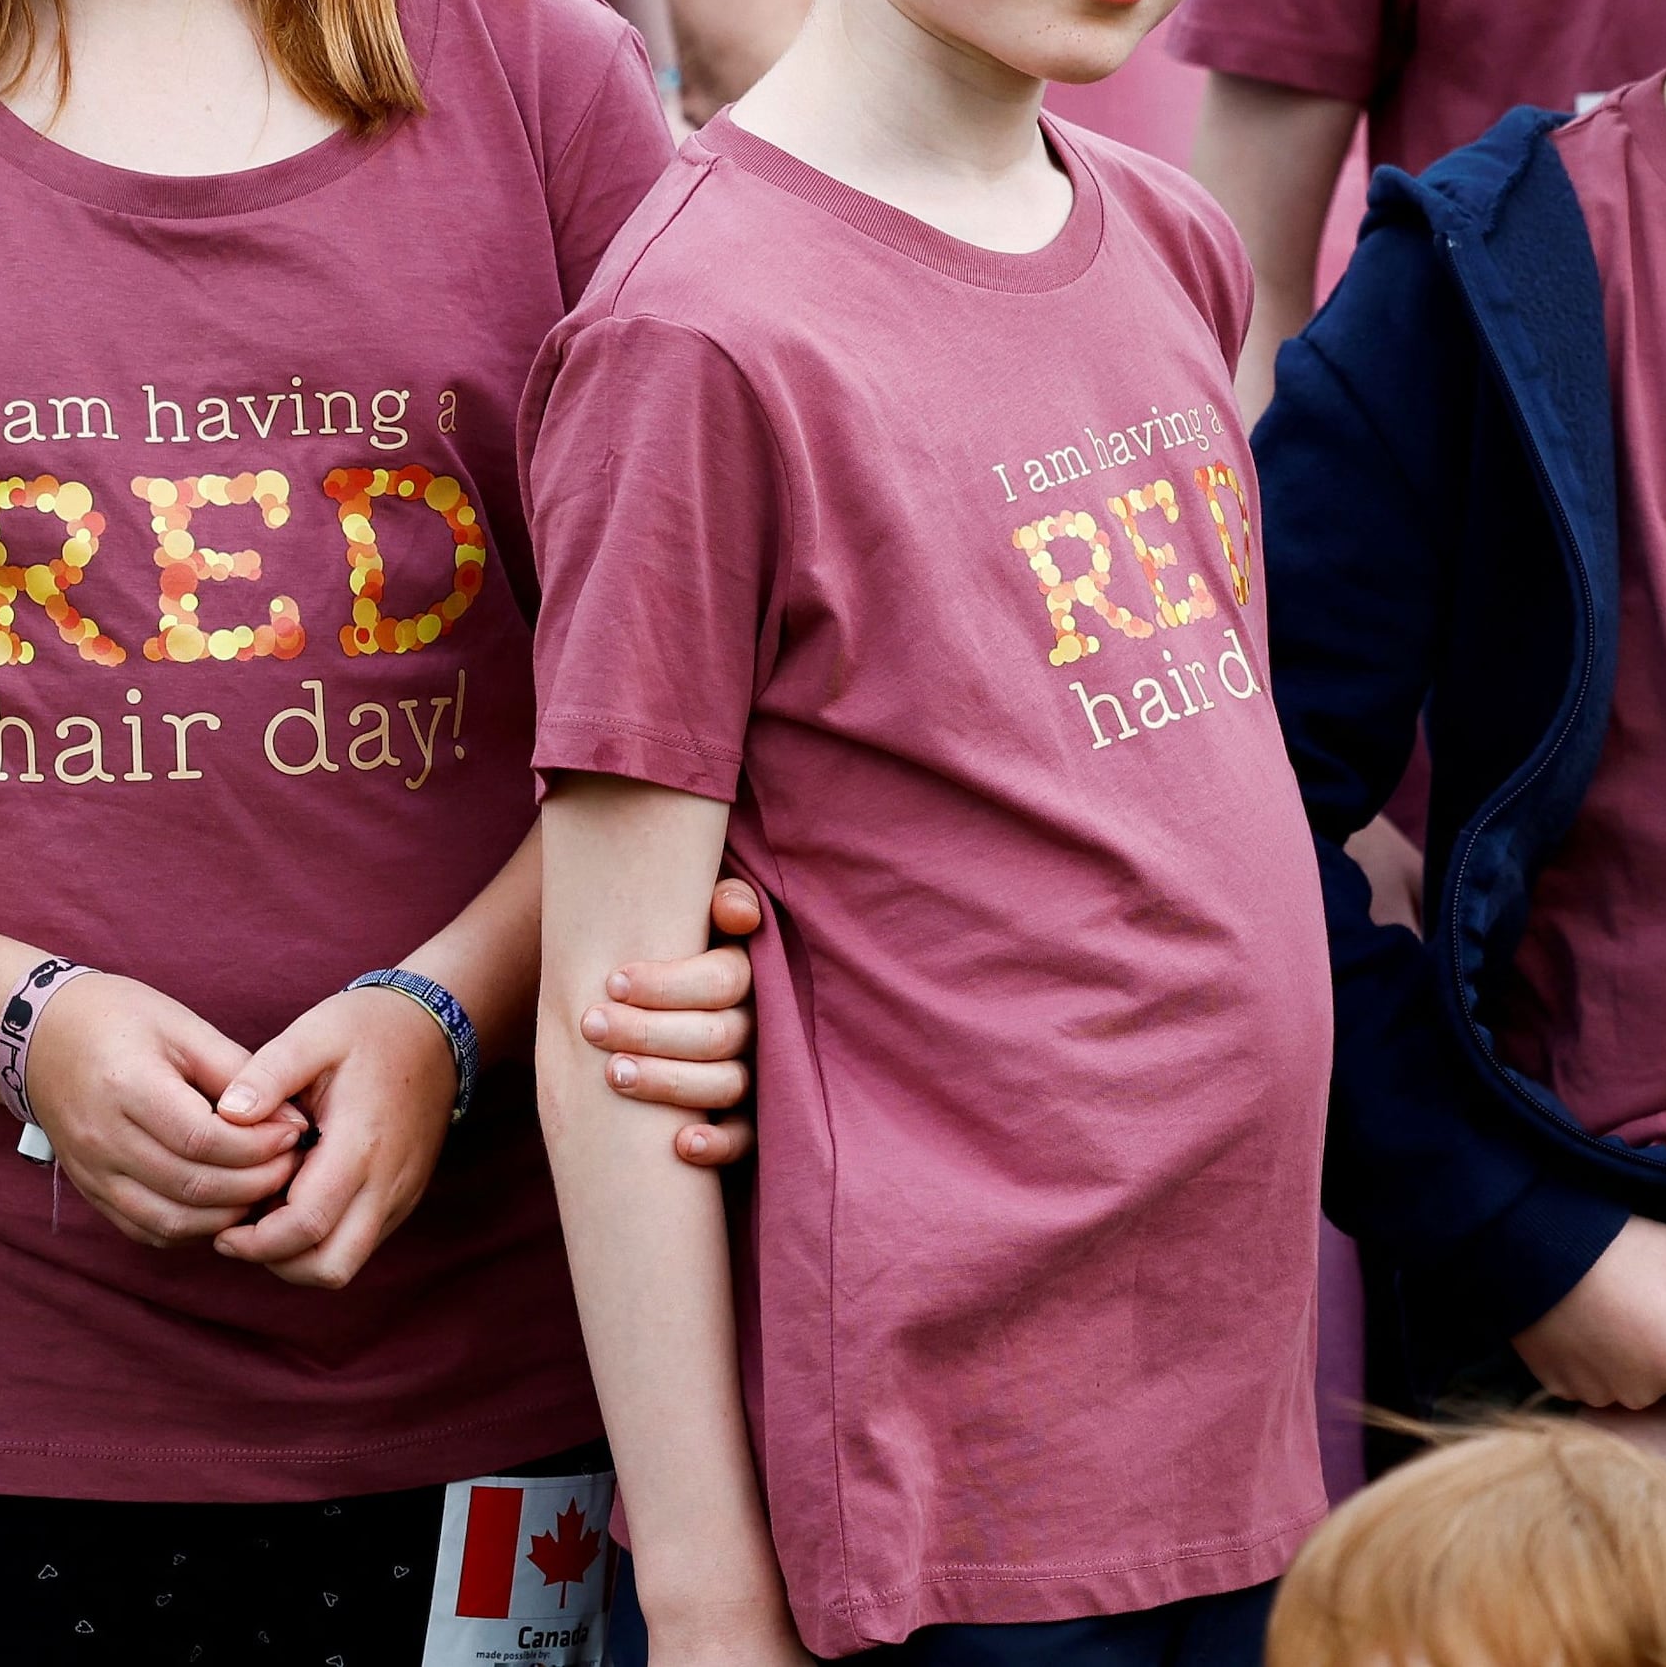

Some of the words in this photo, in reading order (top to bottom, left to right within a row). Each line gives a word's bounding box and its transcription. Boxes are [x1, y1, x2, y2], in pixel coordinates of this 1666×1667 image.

[2, 395, 120, 445] am
[141, 375, 411, 450] having
[437, 390, 458, 434] a
[992, 463, 1018, 503] I
[1023, 445, 1091, 494] am
[1085, 405, 1211, 472] having
[1206, 402, 1225, 435] a
[1012, 460, 1250, 667] RED
[263, 669, 467, 790] day!
[1068, 648, 1216, 751] hair
[476, 1651, 502, 1659] made
[518, 1622, 590, 1649] Canada
